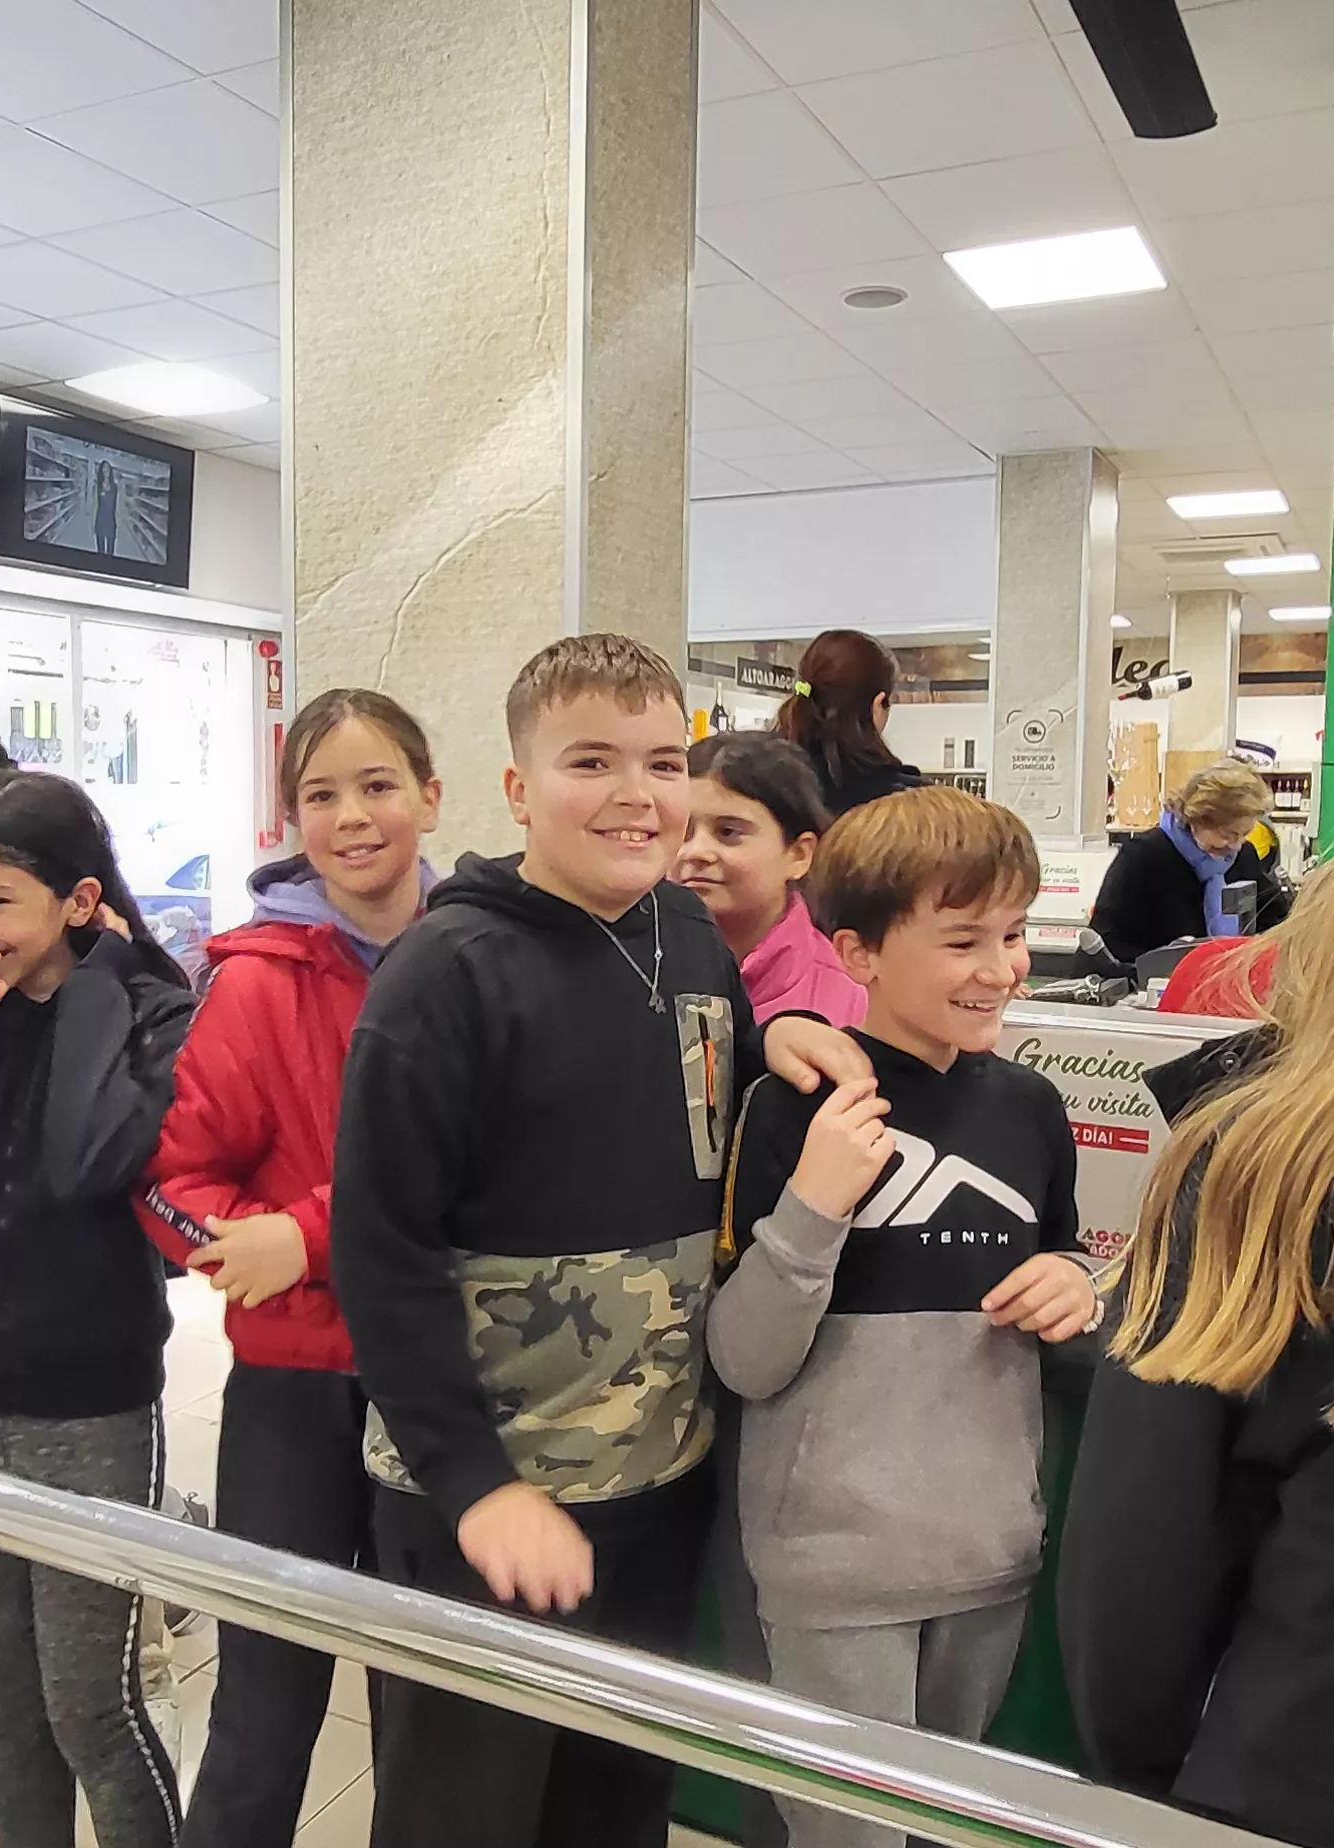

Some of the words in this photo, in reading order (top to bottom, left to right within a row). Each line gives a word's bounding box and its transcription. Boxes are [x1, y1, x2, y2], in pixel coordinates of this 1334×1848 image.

[1012, 763, 1055, 771] DOMICILIO
[1013, 1037, 1146, 1083] Gracias
[1087, 1091, 1154, 1118] visita
[1082, 1125, 1114, 1146] DÍA!
[919, 1230, 1009, 1245] TENTH
